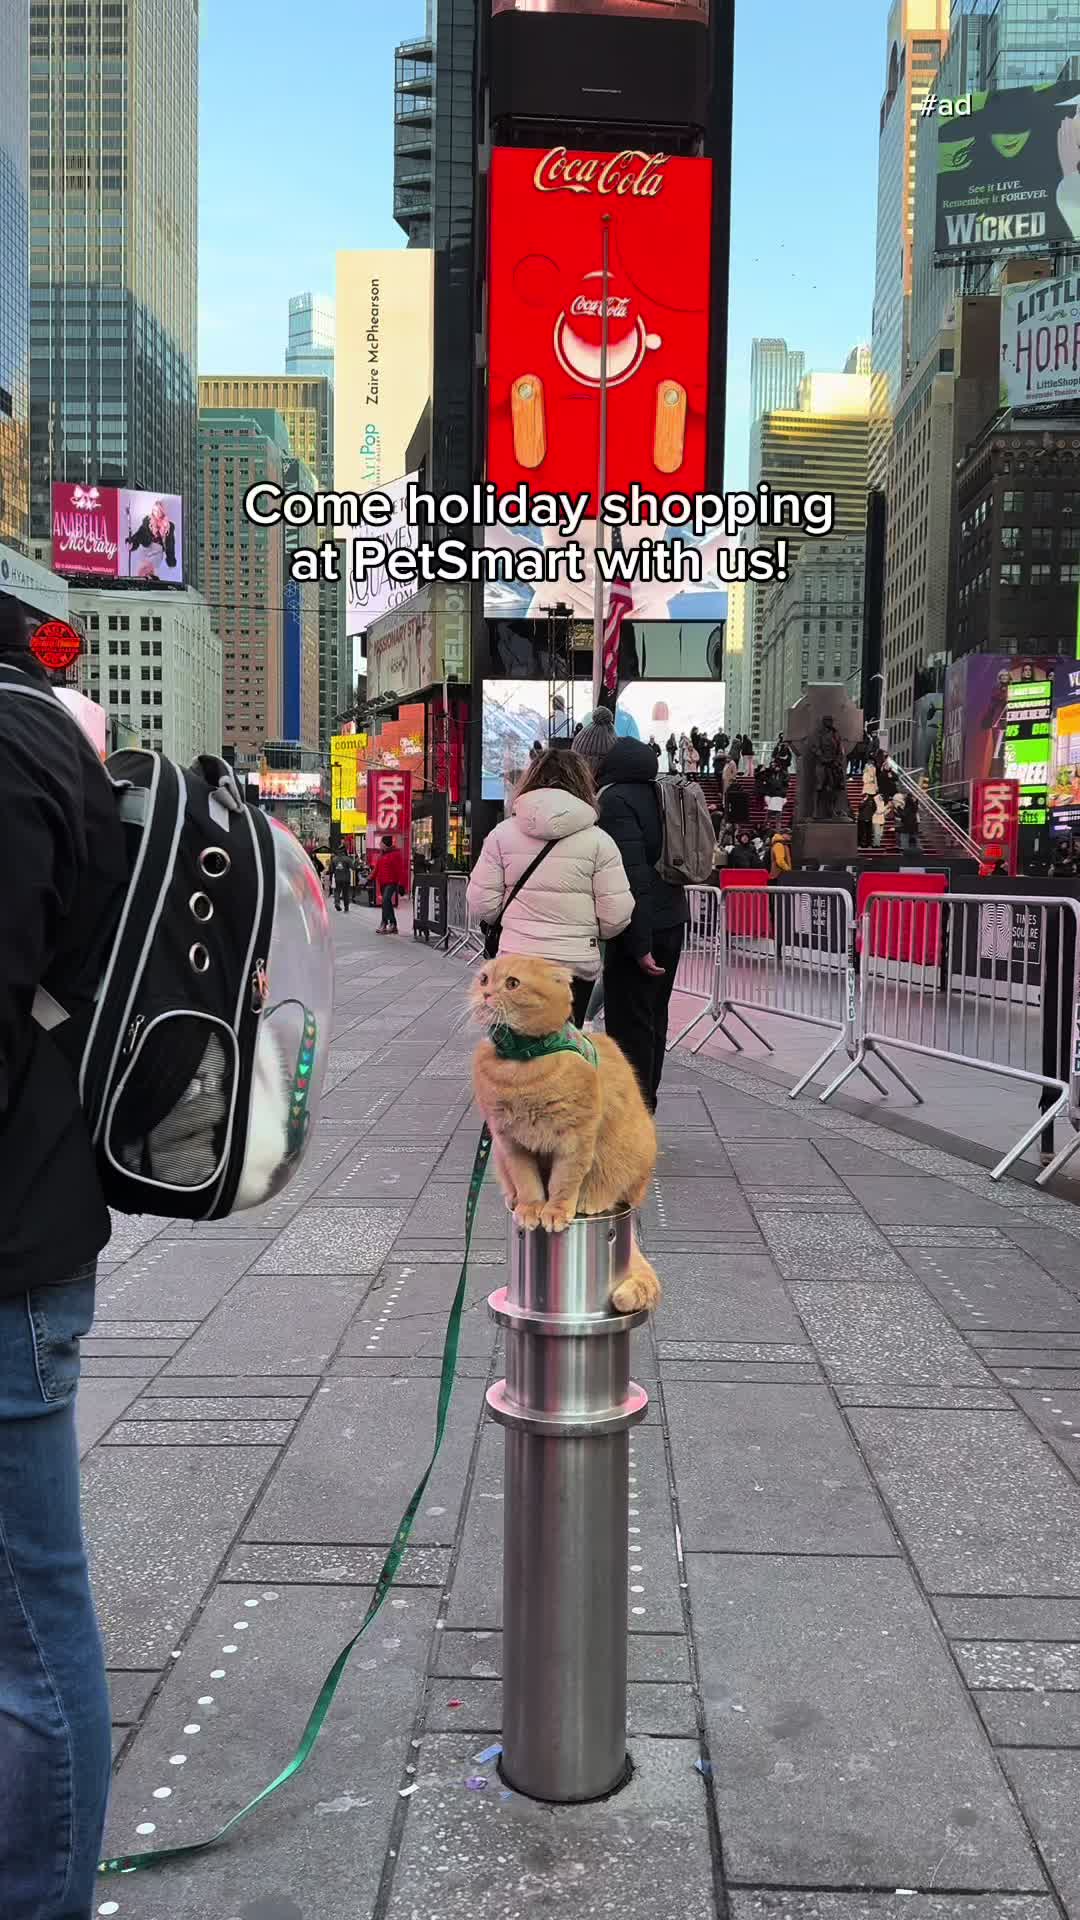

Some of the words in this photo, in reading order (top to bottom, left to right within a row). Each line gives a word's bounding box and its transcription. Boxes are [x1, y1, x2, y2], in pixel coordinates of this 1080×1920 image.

[534, 146, 671, 196] Coca-Cola
[943, 195, 989, 209] Remember
[968, 185, 985, 194] See
[366, 278, 380, 363] McPhearson
[366, 368, 380, 405] Zaire
[53, 511, 108, 543] ANABELLA
[11, 567, 34, 588] HYATT
[377, 774, 405, 829] tkts
[983, 783, 1012, 840] tkts
[1012, 926, 1039, 939] SQURE
